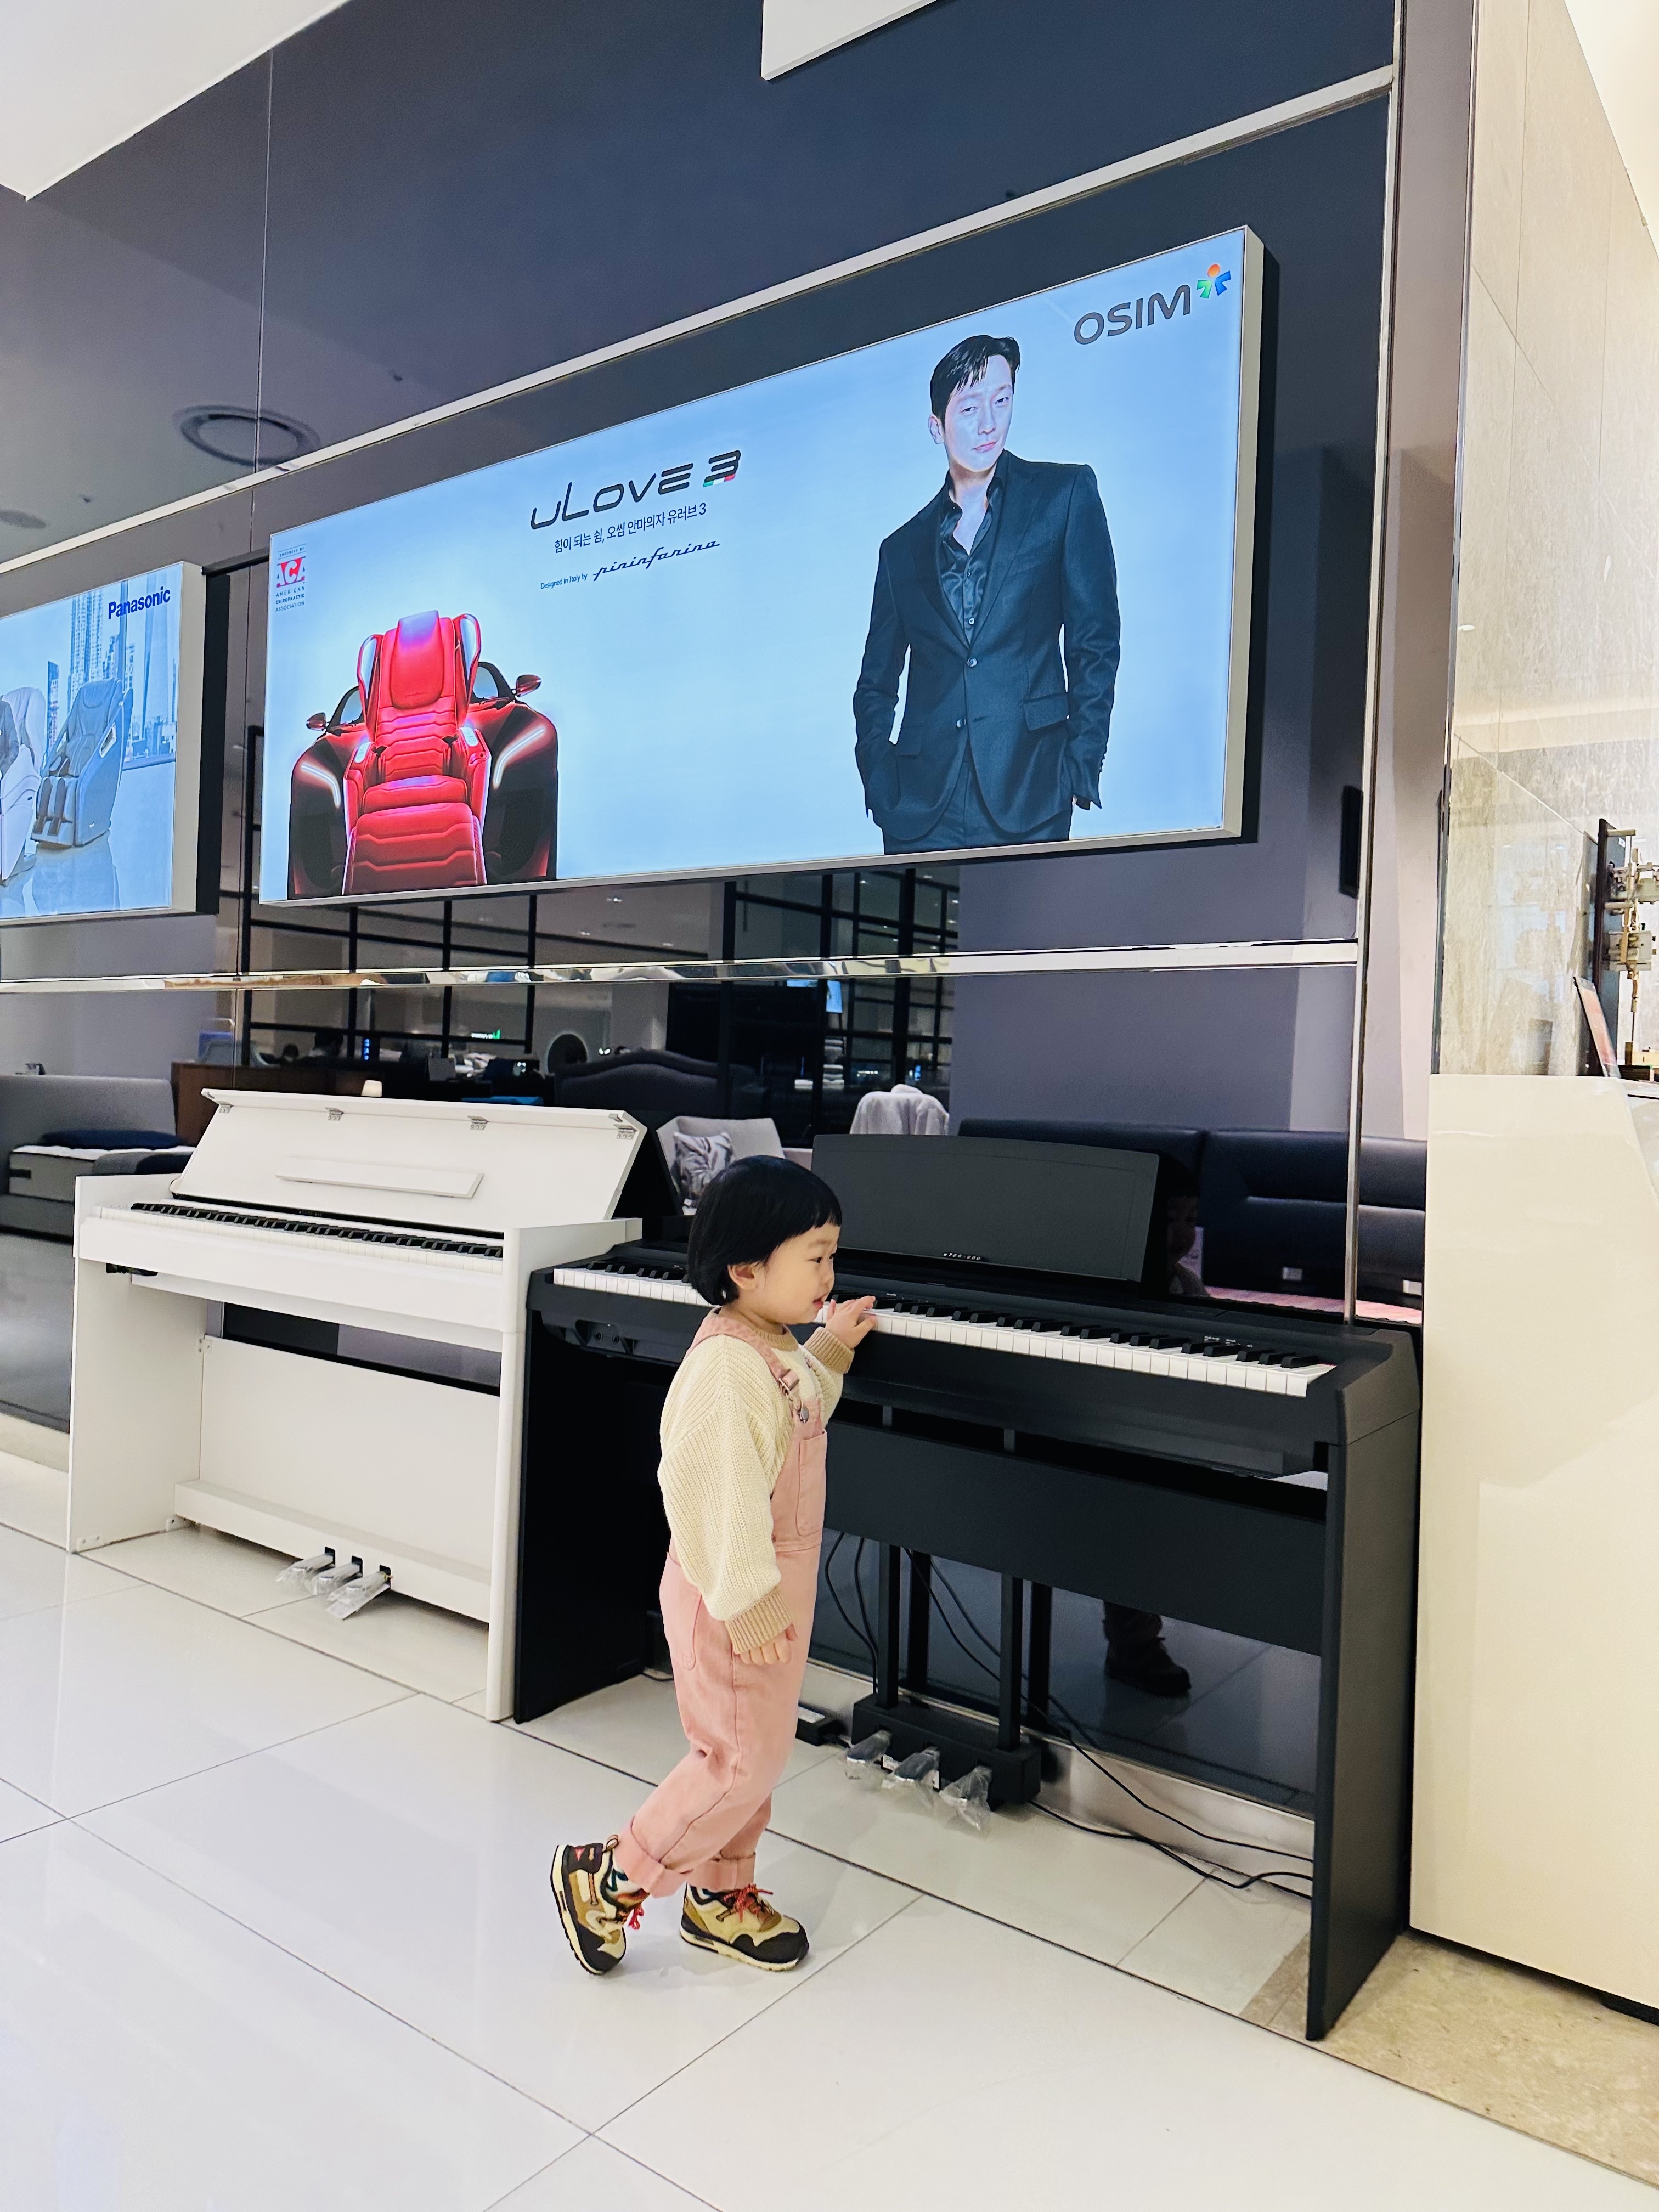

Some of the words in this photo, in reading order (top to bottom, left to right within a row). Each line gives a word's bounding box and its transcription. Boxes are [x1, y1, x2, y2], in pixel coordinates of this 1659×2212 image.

[1074, 284, 1190, 345] OSIM
[704, 450, 741, 483] 3
[555, 537, 571, 553] 힘이
[574, 533, 591, 547] 되는
[594, 528, 605, 543] 쉼,
[607, 522, 625, 539] 오씸
[628, 512, 665, 534] 안마의자
[668, 505, 697, 524] 유러브
[699, 503, 706, 515] 3
[594, 540, 720, 581] pininfarina
[276, 586, 304, 597] AMERICAN
[540, 578, 562, 589] Designed
[569, 574, 580, 583] Italy
[108, 586, 171, 619] Panasonic
[275, 600, 304, 612] ASSOCIATION
